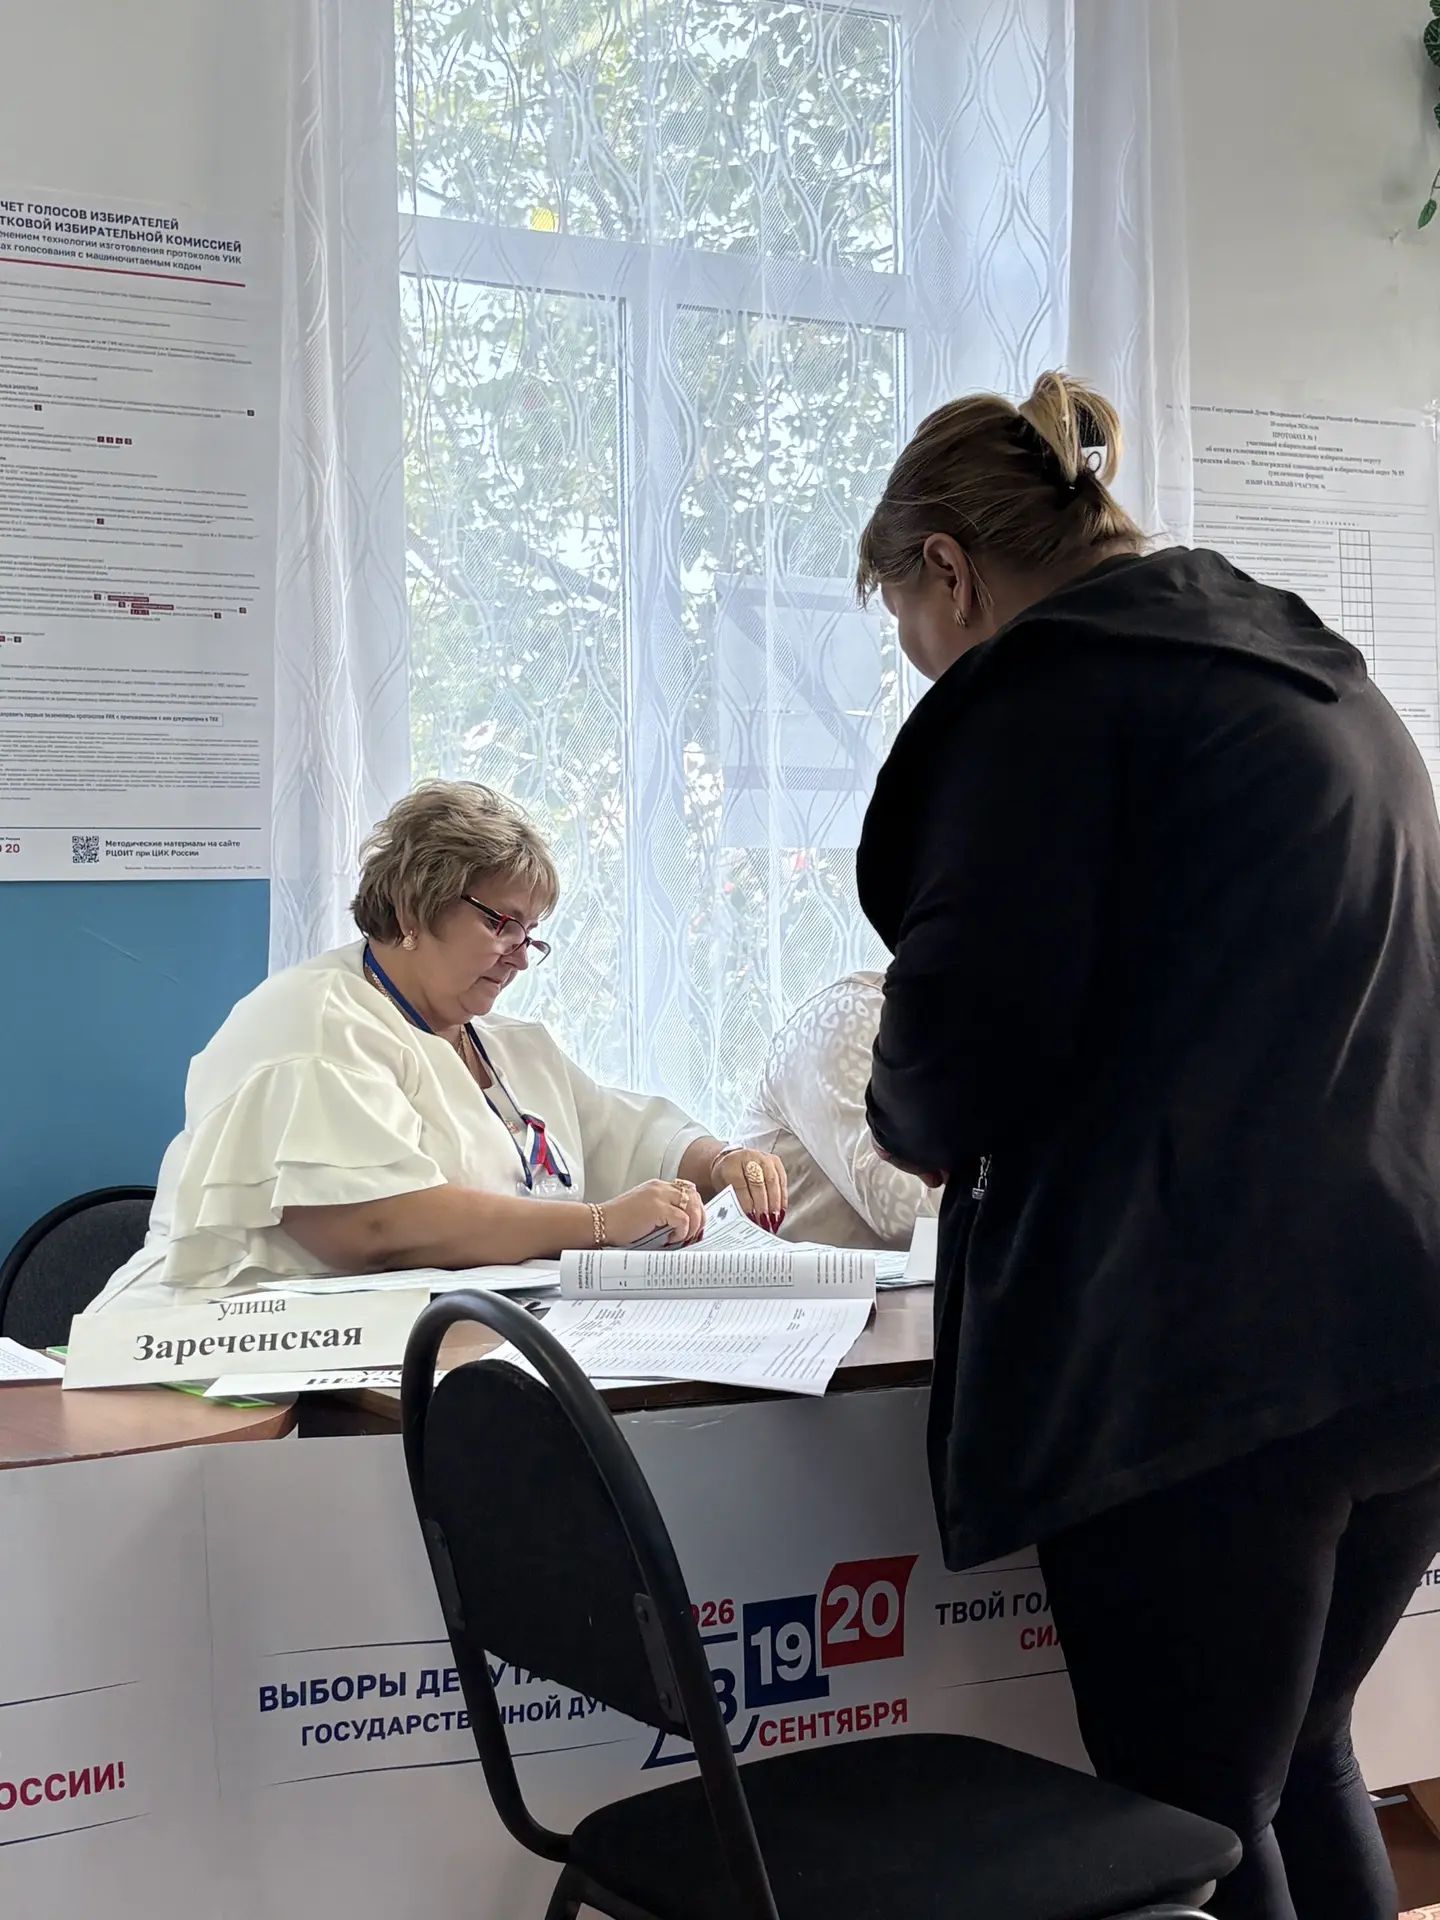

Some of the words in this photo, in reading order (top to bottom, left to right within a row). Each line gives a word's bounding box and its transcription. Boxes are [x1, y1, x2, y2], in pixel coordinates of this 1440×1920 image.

[27, 203, 87, 220] ГОЛОСОВ
[90, 211, 179, 230] ИЗБИРАТЕЛЕЙ
[42, 235, 98, 248] технологии
[100, 242, 164, 255] изготовления
[166, 249, 220, 262] протоколов
[222, 255, 242, 264] УИК
[55, 221, 163, 243] ИЗБИРАТЕЛЬНОЙ
[166, 234, 242, 253] КОМИССИЕЙ
[14, 244, 76, 257] голосования
[86, 252, 171, 268] машиночитаемым
[173, 262, 202, 271] кодом
[5, 844, 20, 854] 20
[105, 840, 163, 848] Методические
[218, 840, 241, 848] сайте
[135, 850, 151, 858] при
[171, 849, 200, 857] России
[217, 1299, 287, 1321] улица
[133, 1325, 363, 1366] Зареченская
[826, 1579, 900, 1645] 20
[935, 1590, 1004, 1625] ТВОЙ
[750, 1620, 812, 1686] 19
[259, 1671, 407, 1712] ВЫБОРЫ
[301, 1694, 561, 1746] ГОСУДАРСТВНОЙ
[567, 1695, 608, 1721] ДУ
[758, 1697, 909, 1748] СЕНТЯБРЯ
